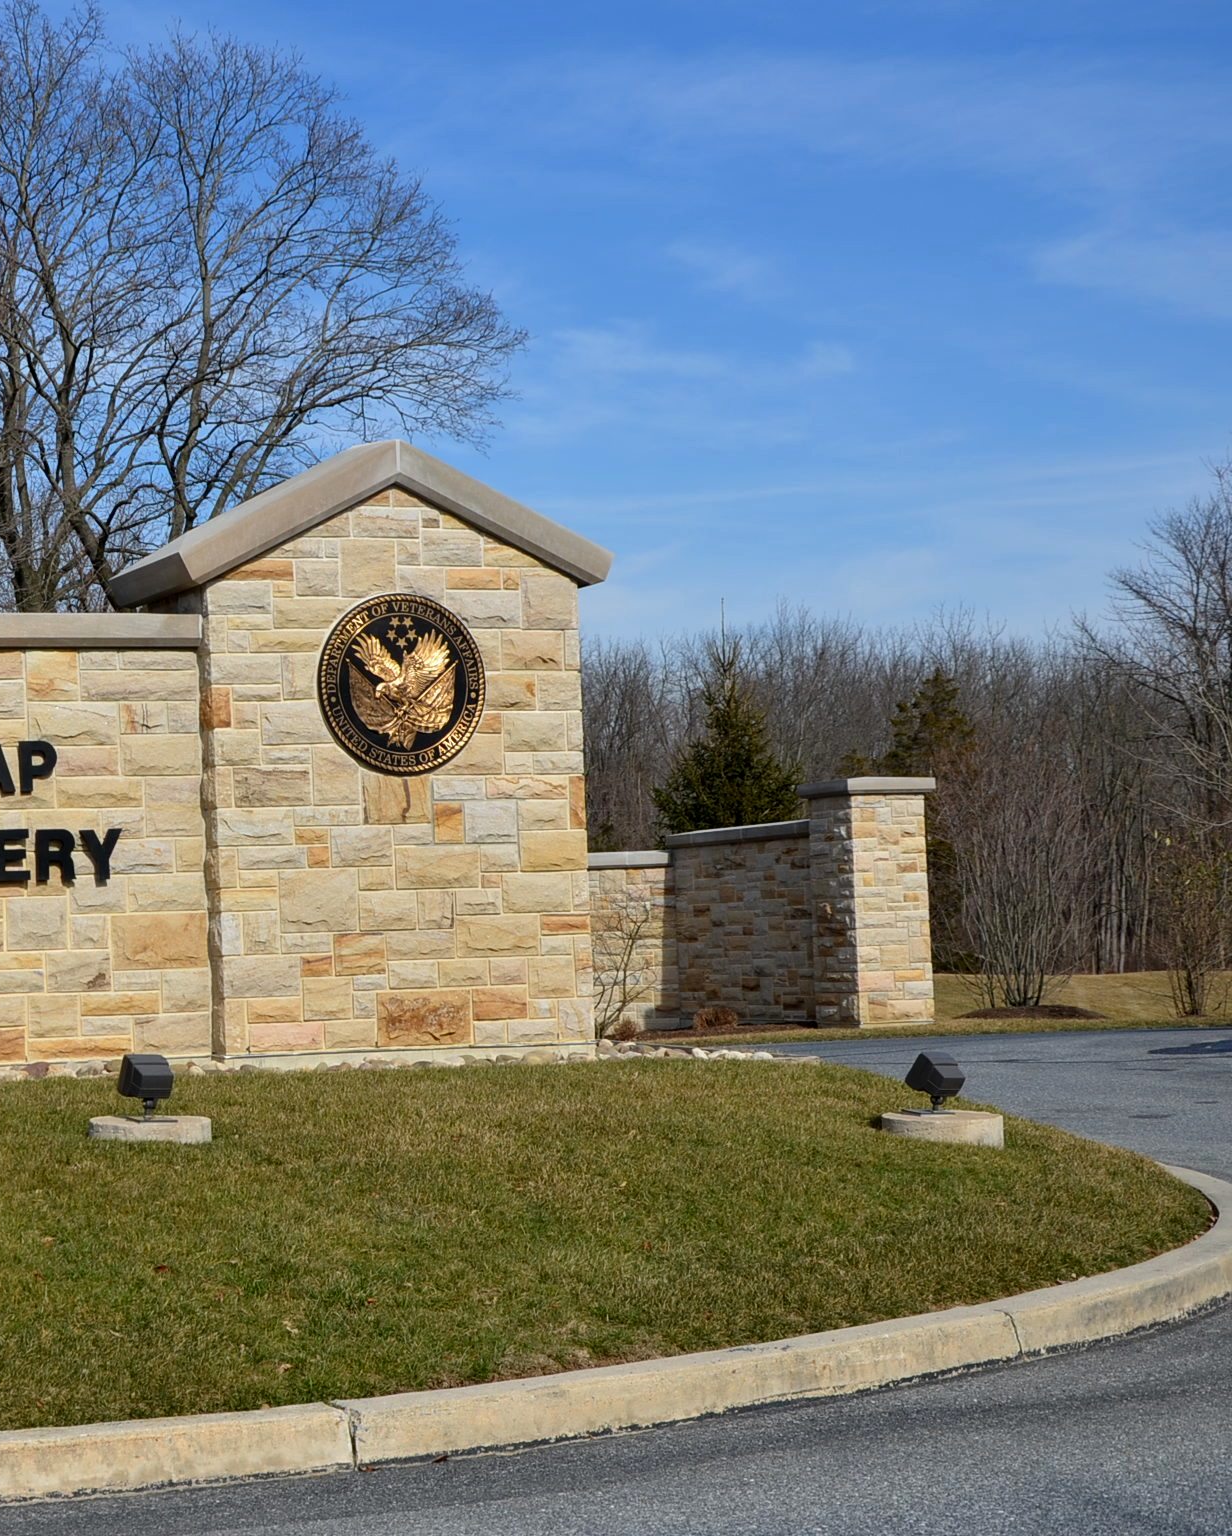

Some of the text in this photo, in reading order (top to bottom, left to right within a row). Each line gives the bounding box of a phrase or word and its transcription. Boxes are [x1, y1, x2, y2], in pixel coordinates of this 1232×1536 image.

[328, 601, 479, 694] DEPARTMENT OF VETERANS AFFAIRS
[332, 703, 476, 766] UNITED STATES OF AMERICA
